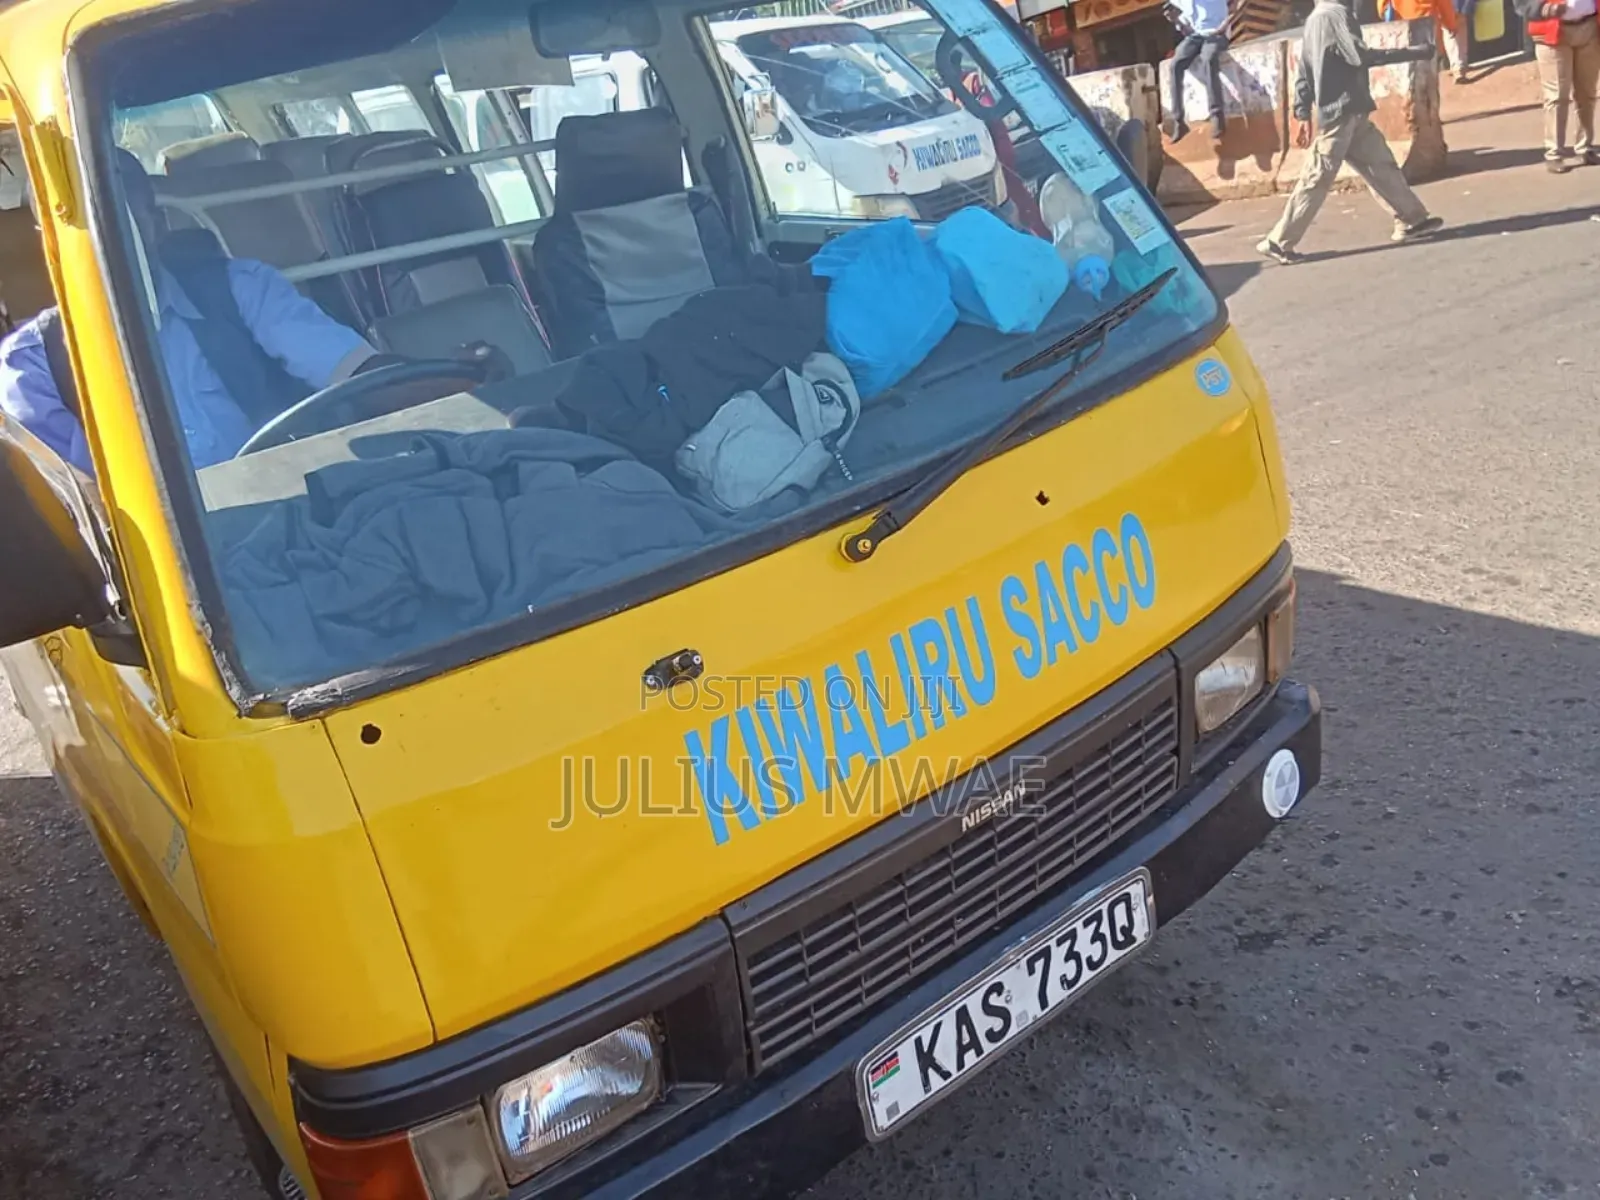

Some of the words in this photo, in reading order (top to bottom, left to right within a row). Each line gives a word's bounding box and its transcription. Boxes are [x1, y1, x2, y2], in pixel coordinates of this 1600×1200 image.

[682, 595, 997, 846] KIWALIRU
[1000, 511, 1157, 680] SACCO
[961, 778, 1027, 833] NISSAN
[913, 980, 1013, 1095] KAS
[1025, 891, 1138, 1012] 733Q
